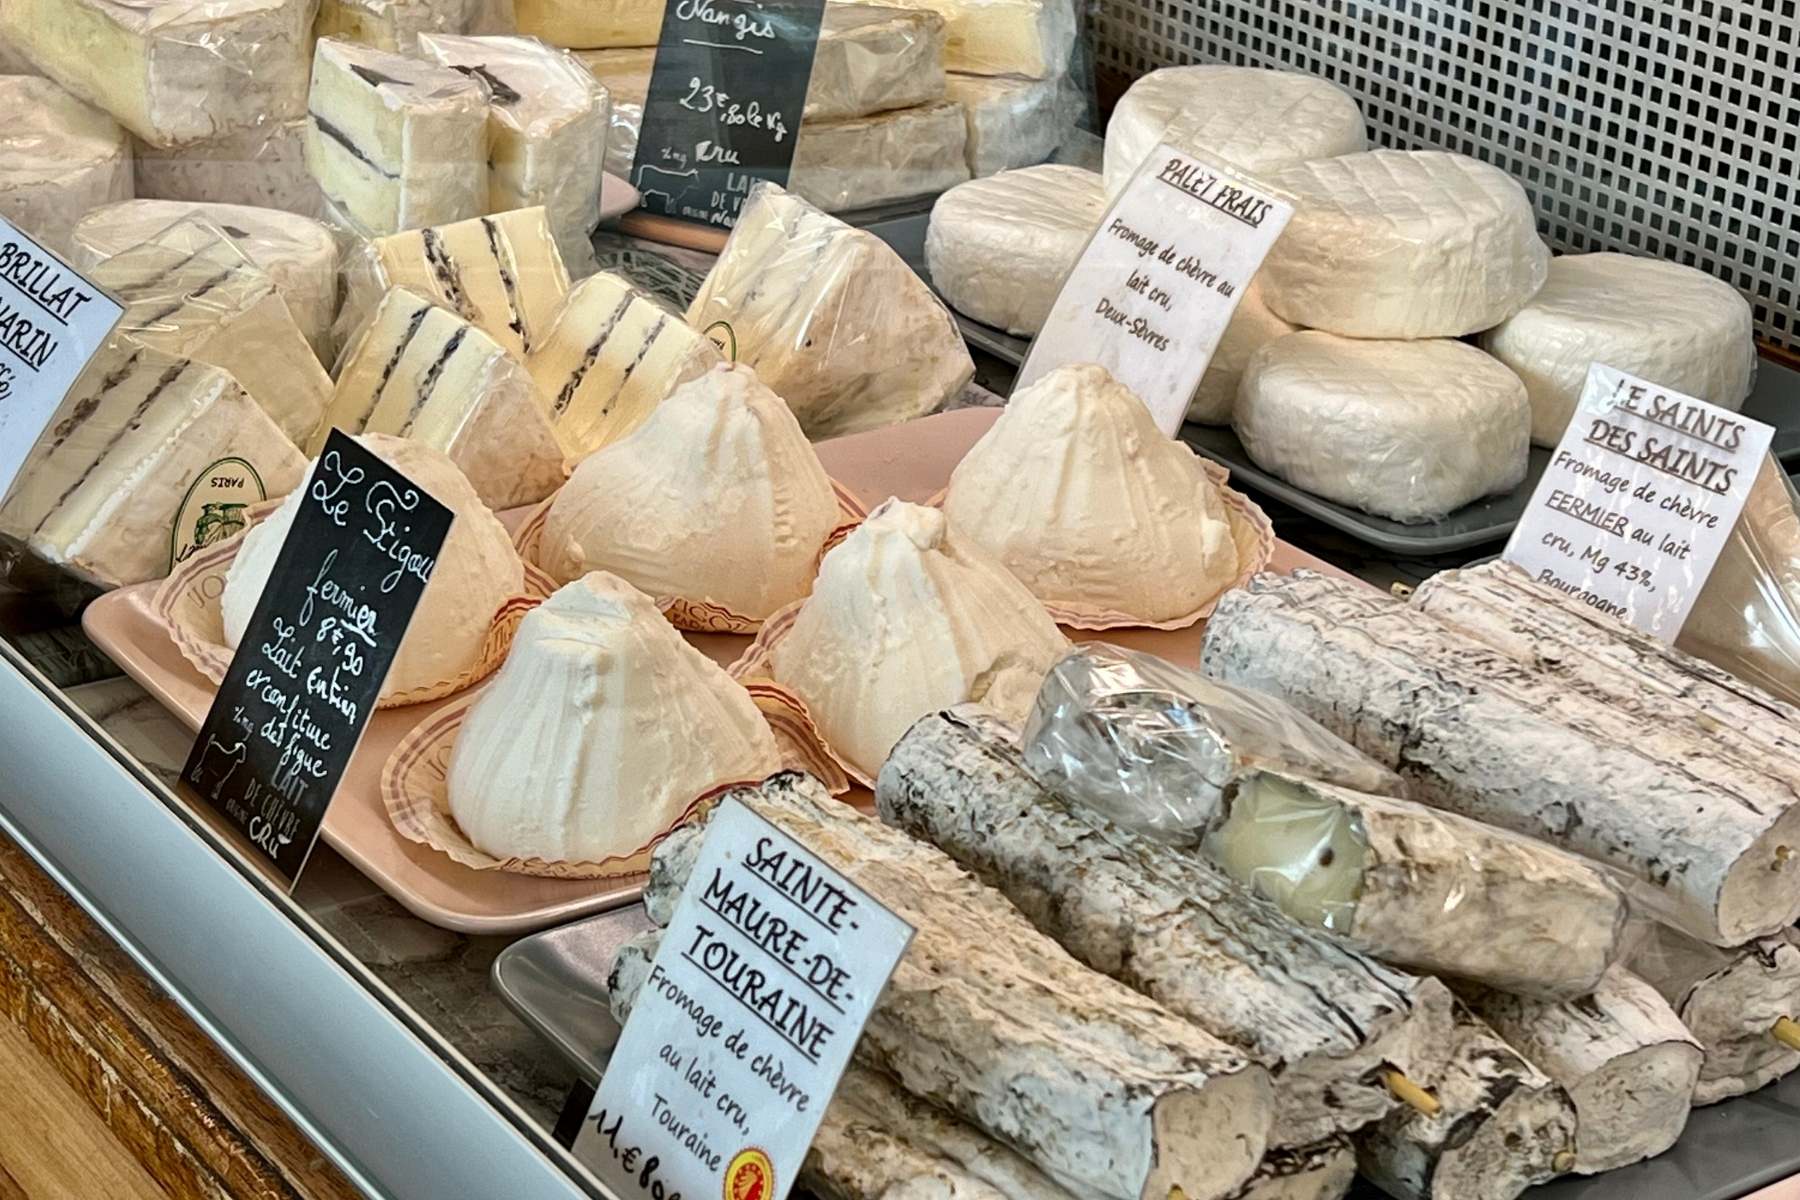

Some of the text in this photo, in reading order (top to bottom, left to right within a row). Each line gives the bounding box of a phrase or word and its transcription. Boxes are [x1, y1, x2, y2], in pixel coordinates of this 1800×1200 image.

[1213, 184, 1274, 227] FRAIS
[0, 242, 92, 319] BRILLAT
[1107, 218, 1236, 298] Fromage de chèvre au
[1126, 269, 1173, 312] lait cru,
[1095, 297, 1171, 352] Deux-Sèvres
[1588, 419, 1738, 493] DES SAINTS
[1645, 395, 1746, 451] SAINTS
[211, 477, 245, 489] PARIS
[312, 450, 365, 526] Le
[1553, 450, 1720, 530] Fromage de chèvre
[1546, 489, 1692, 560] FERMIER au lait
[300, 549, 377, 635] fermier
[1541, 531, 1656, 593] cru, Mg 43%,
[261, 617, 305, 678] Lait
[261, 681, 331, 750] confiture
[244, 777, 262, 807] DE
[271, 762, 309, 806] LAIT
[745, 837, 859, 930] SAINTE-
[703, 867, 854, 1001] MAURE-DE-
[688, 925, 834, 1058] TOURAINE
[647, 965, 810, 1112] Fromage de chèvre
[660, 1044, 750, 1136] au lait cru,
[651, 1092, 722, 1172] Touraine
